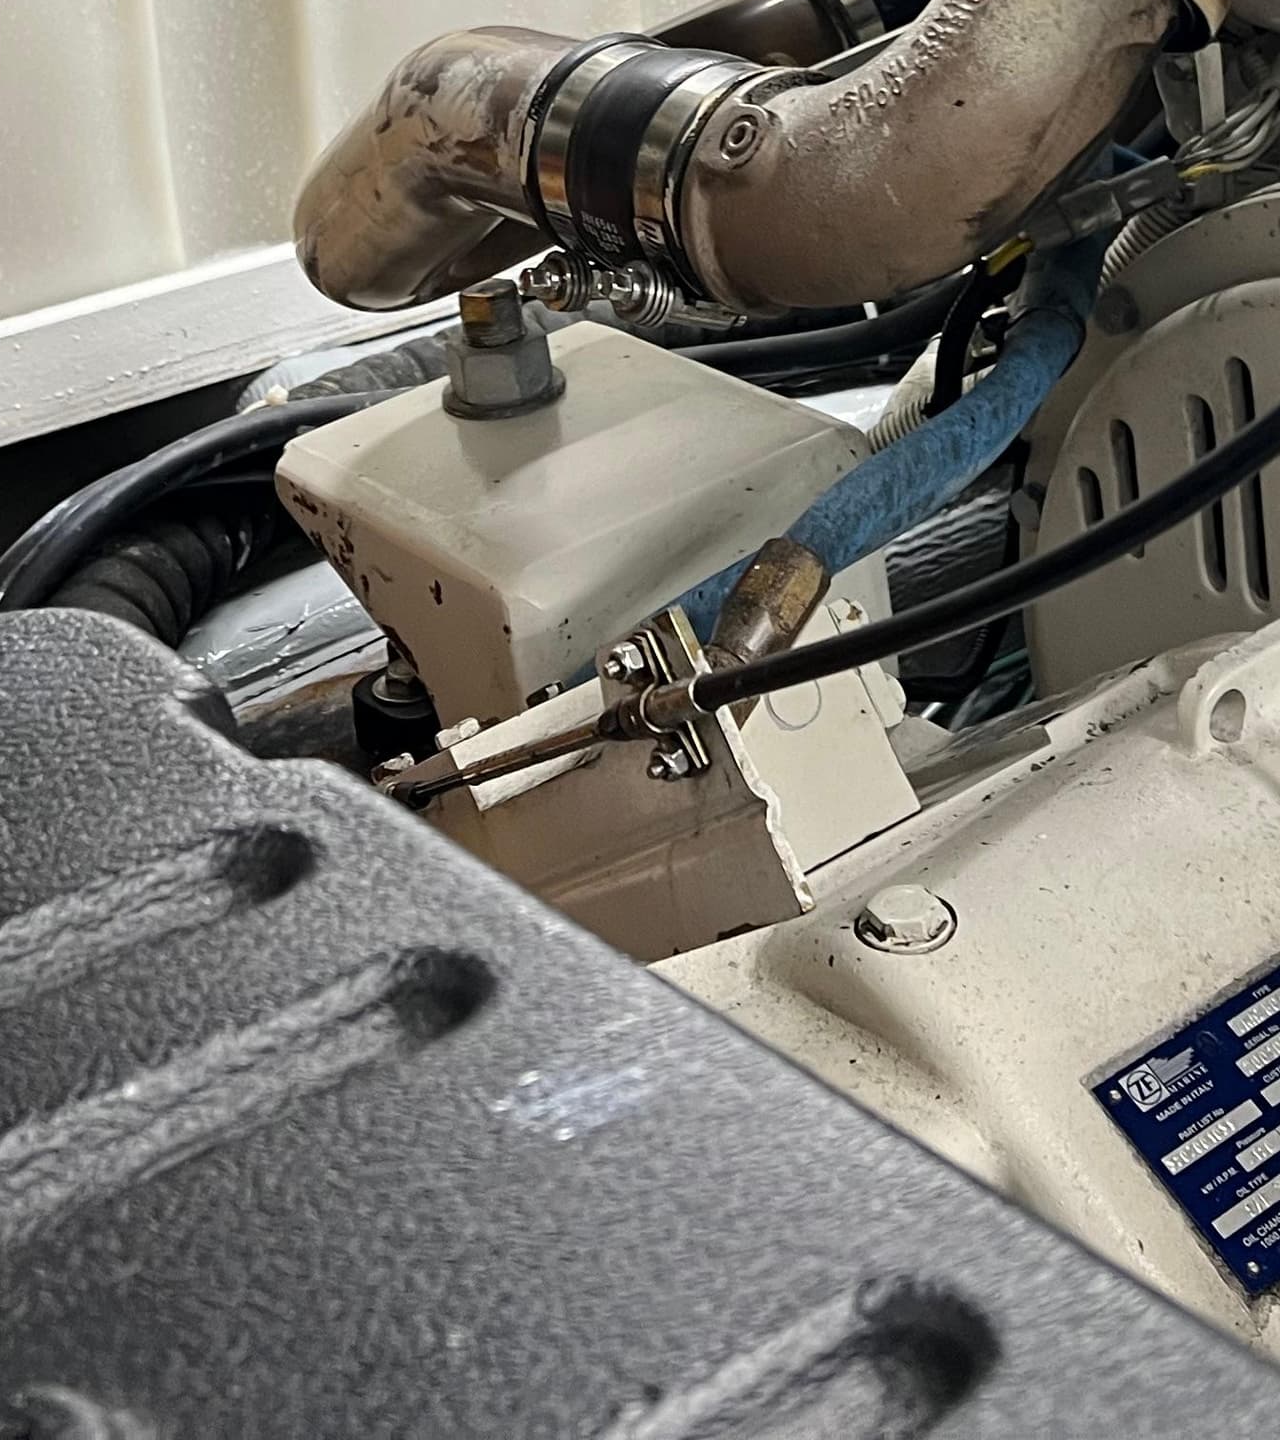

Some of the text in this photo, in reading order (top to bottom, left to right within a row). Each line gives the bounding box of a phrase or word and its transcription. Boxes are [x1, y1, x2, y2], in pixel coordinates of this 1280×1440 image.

[1252, 982, 1271, 1000] TYPE
[1243, 1029, 1269, 1050] SERIAL
[1166, 1063, 1208, 1094] MARINE
[1155, 1078, 1215, 1123] MADE IN ITALY
[1177, 1122, 1198, 1141] PART
[1196, 1112, 1214, 1129] LIST
[1235, 1170, 1269, 1199] OIL TYPE
[1241, 1230, 1260, 1248] OIL
[1260, 1230, 1280, 1250] 1000
